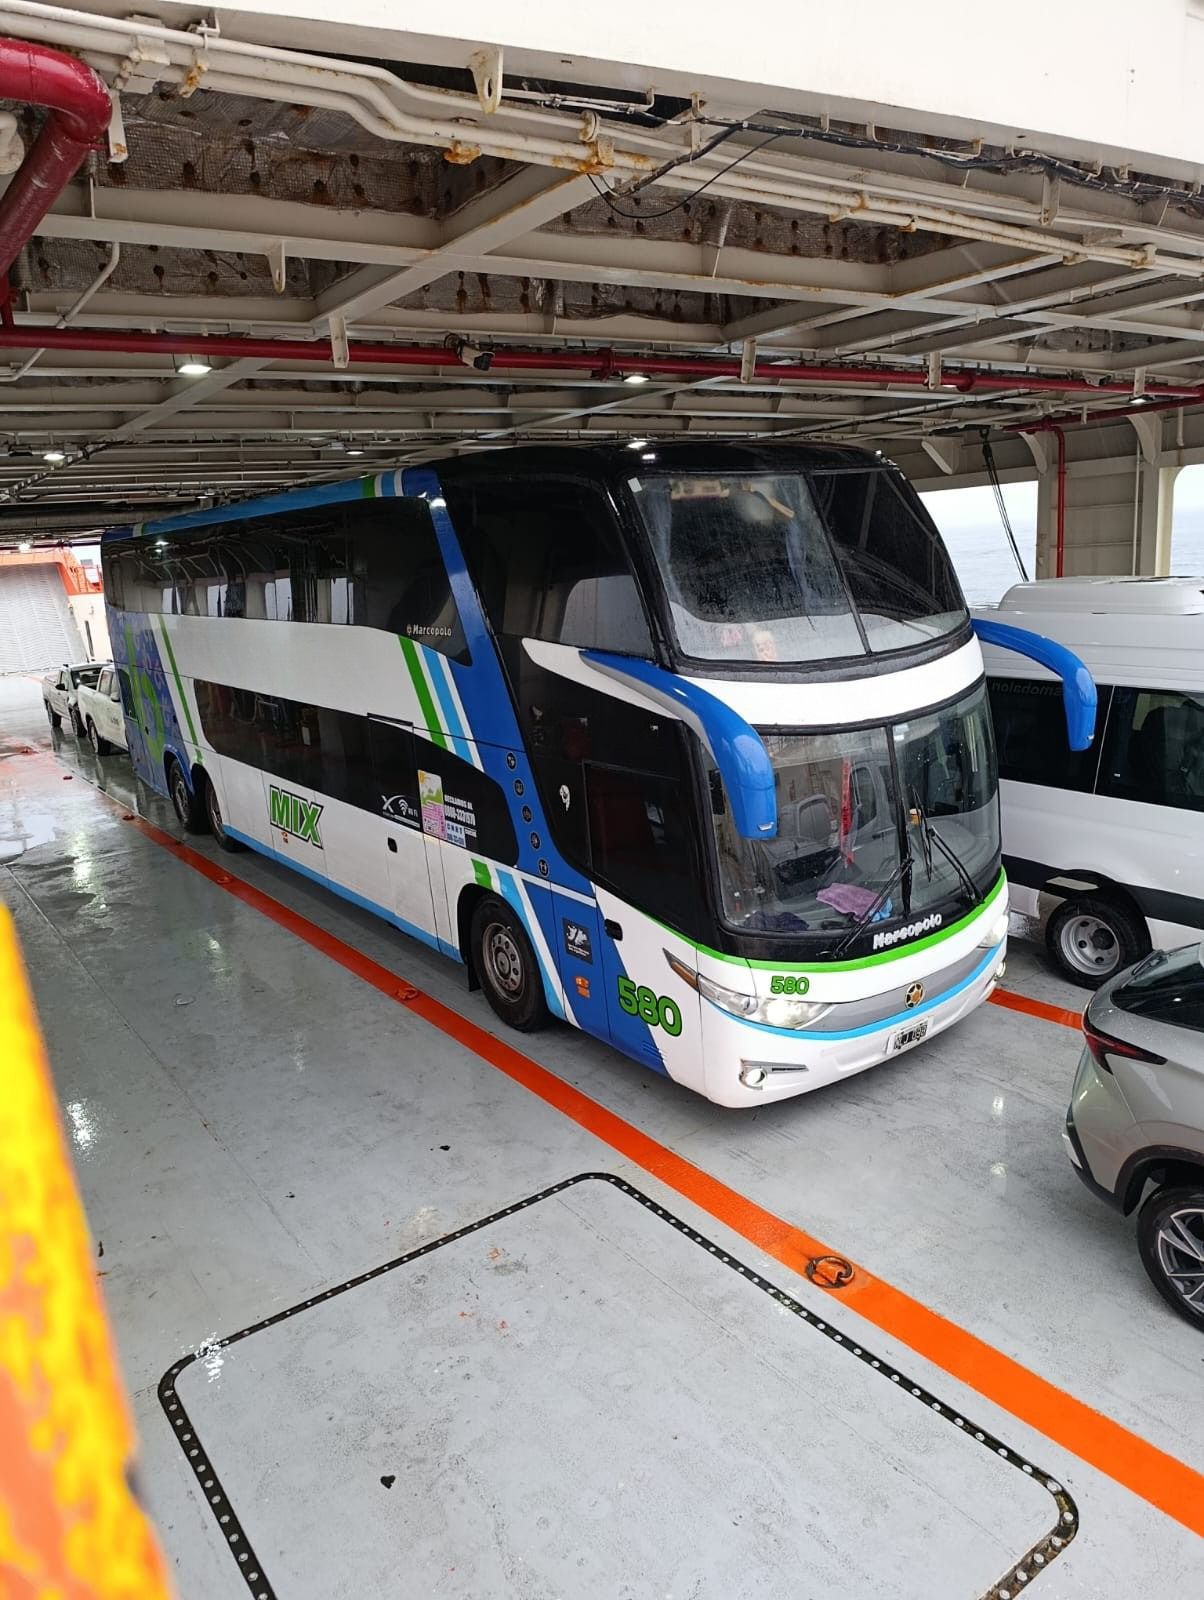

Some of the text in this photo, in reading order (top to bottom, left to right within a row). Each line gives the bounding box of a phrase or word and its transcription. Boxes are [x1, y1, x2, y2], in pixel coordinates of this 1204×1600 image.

[412, 623, 452, 637] Marcopolo
[270, 784, 324, 850] MIX
[873, 914, 942, 949] Marcopolo
[770, 975, 810, 996] 580
[617, 974, 683, 1038] 580
